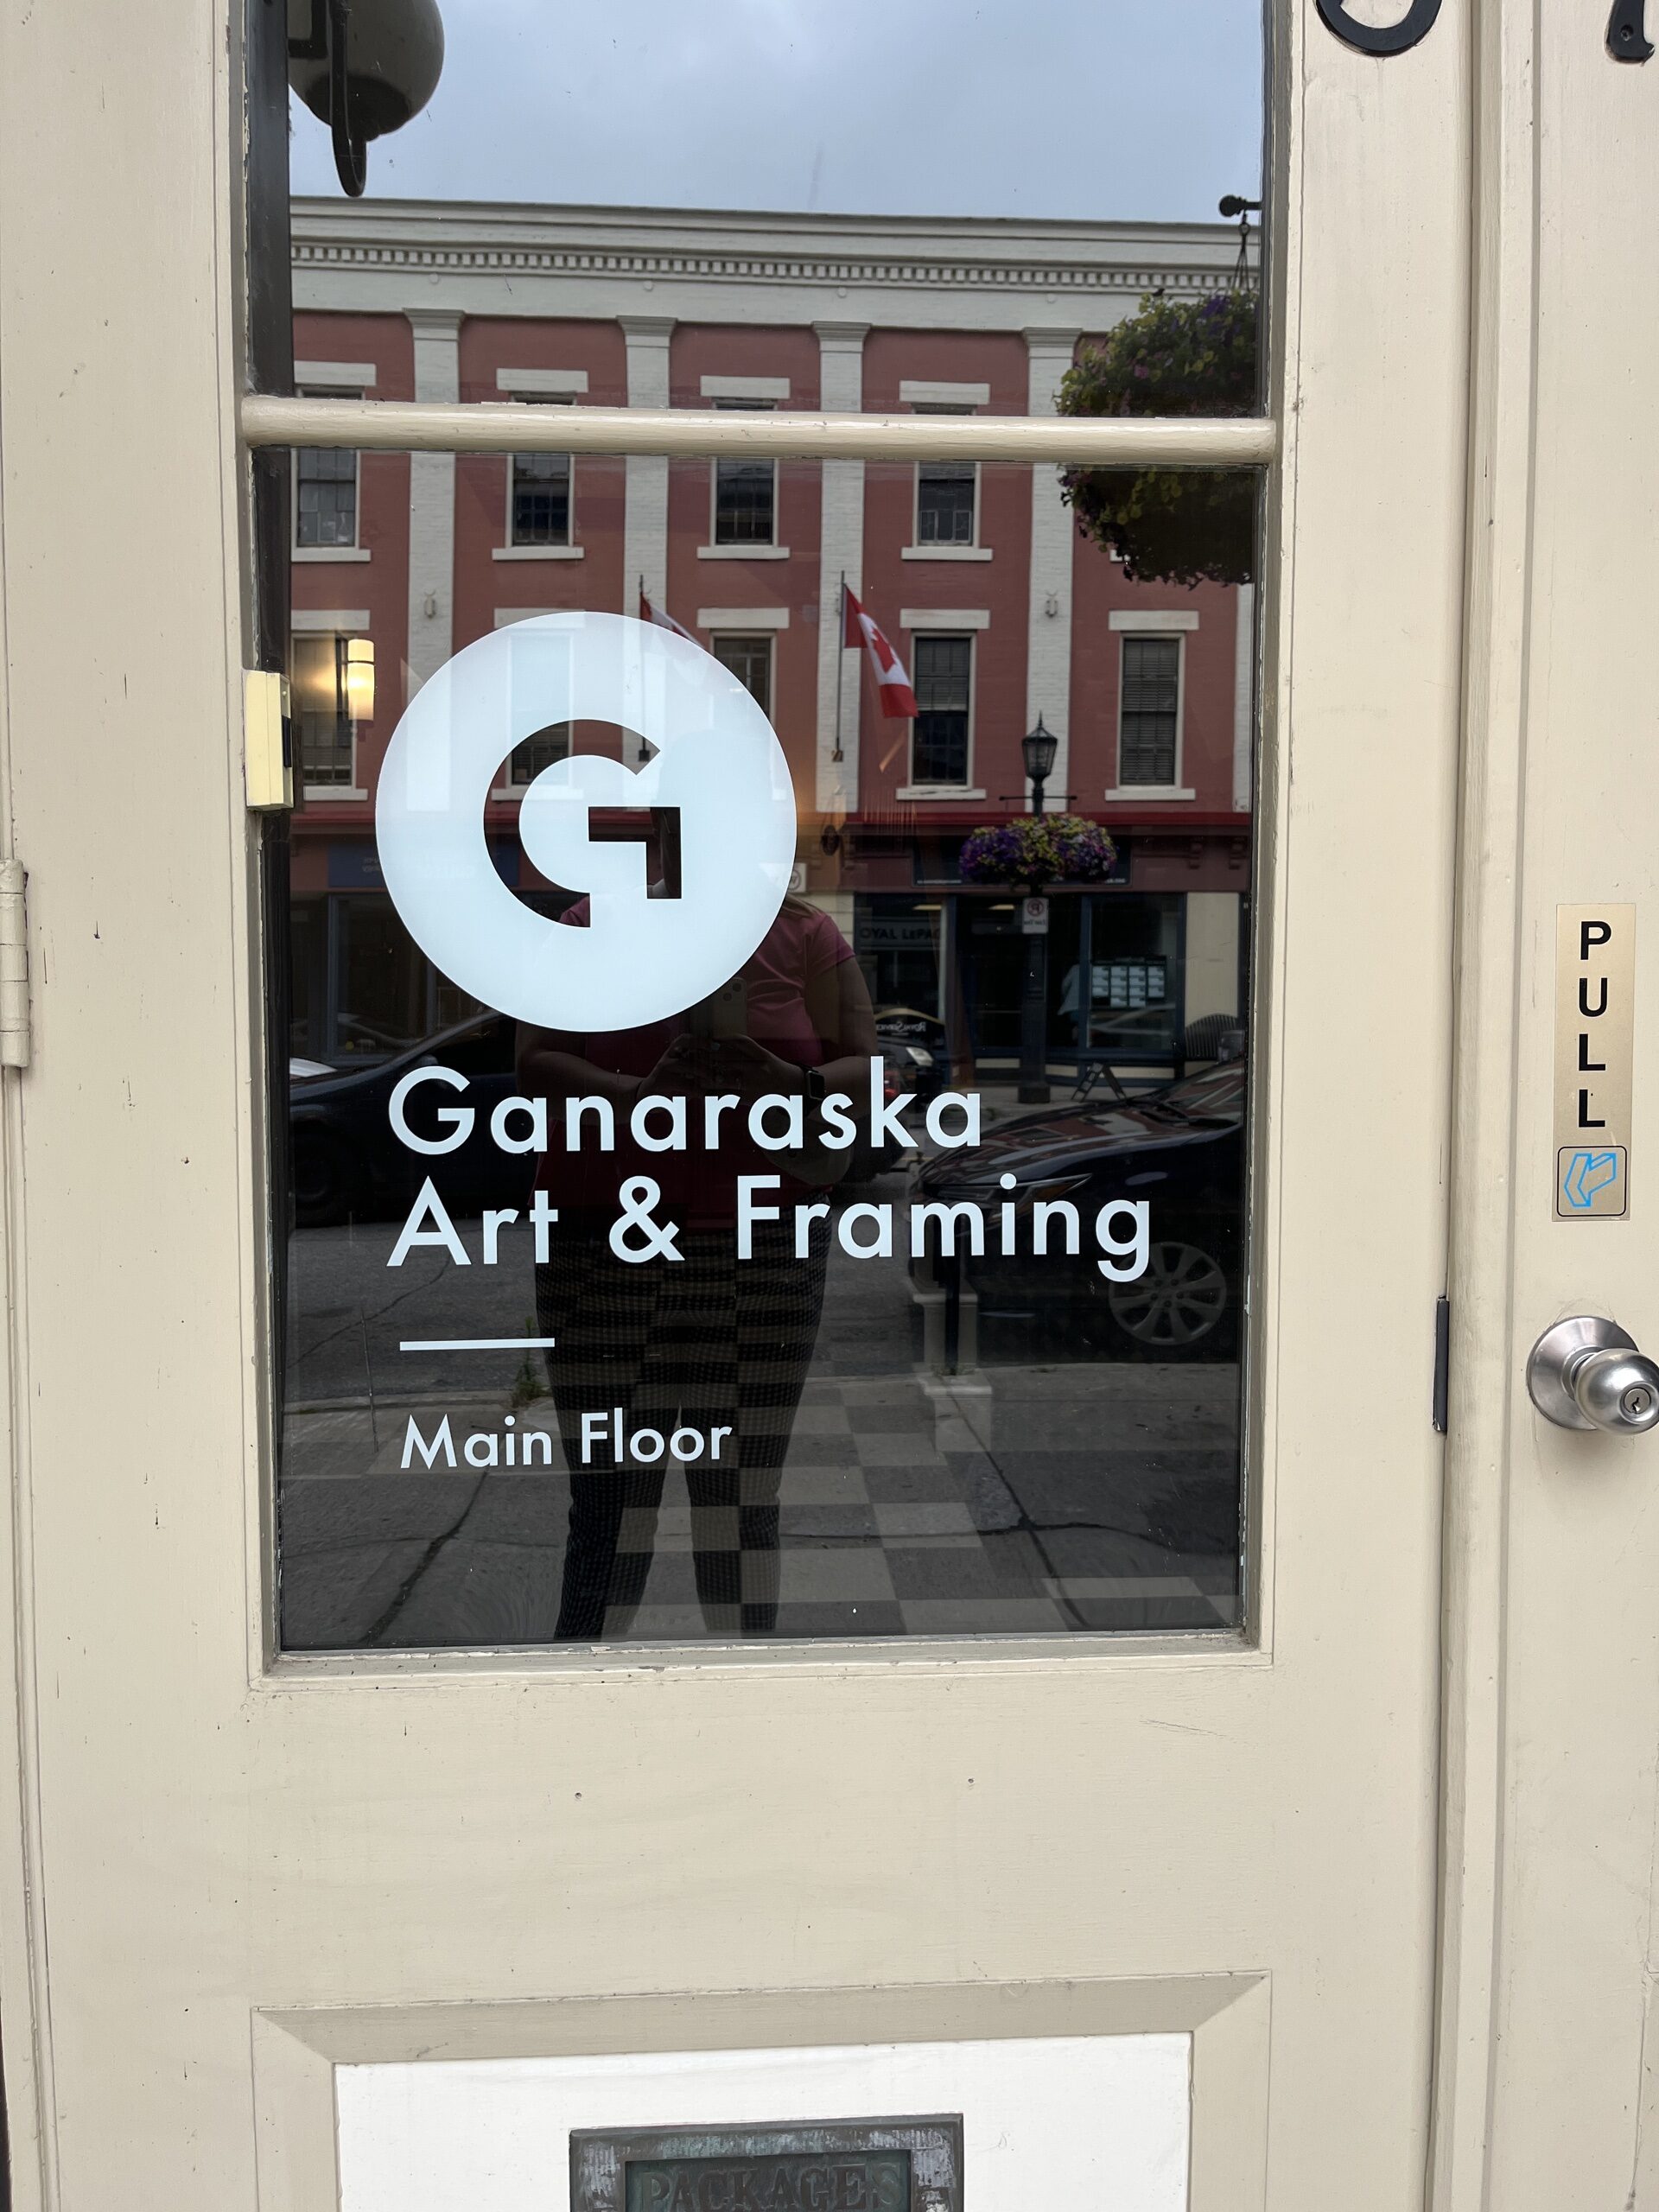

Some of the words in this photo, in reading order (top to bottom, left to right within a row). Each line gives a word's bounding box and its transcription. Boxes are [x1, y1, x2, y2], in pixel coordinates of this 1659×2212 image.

[484, 719, 683, 928] G
[1579, 921, 1612, 1128] PULL
[389, 1056, 982, 1155] Ganaraska
[387, 1176, 559, 1267] Art
[609, 1176, 685, 1263] &
[737, 1173, 1151, 1282] Framing
[401, 1414, 552, 1470] Main
[582, 1408, 733, 1464] Floor
[639, 2162, 903, 2212] PACKAGES
